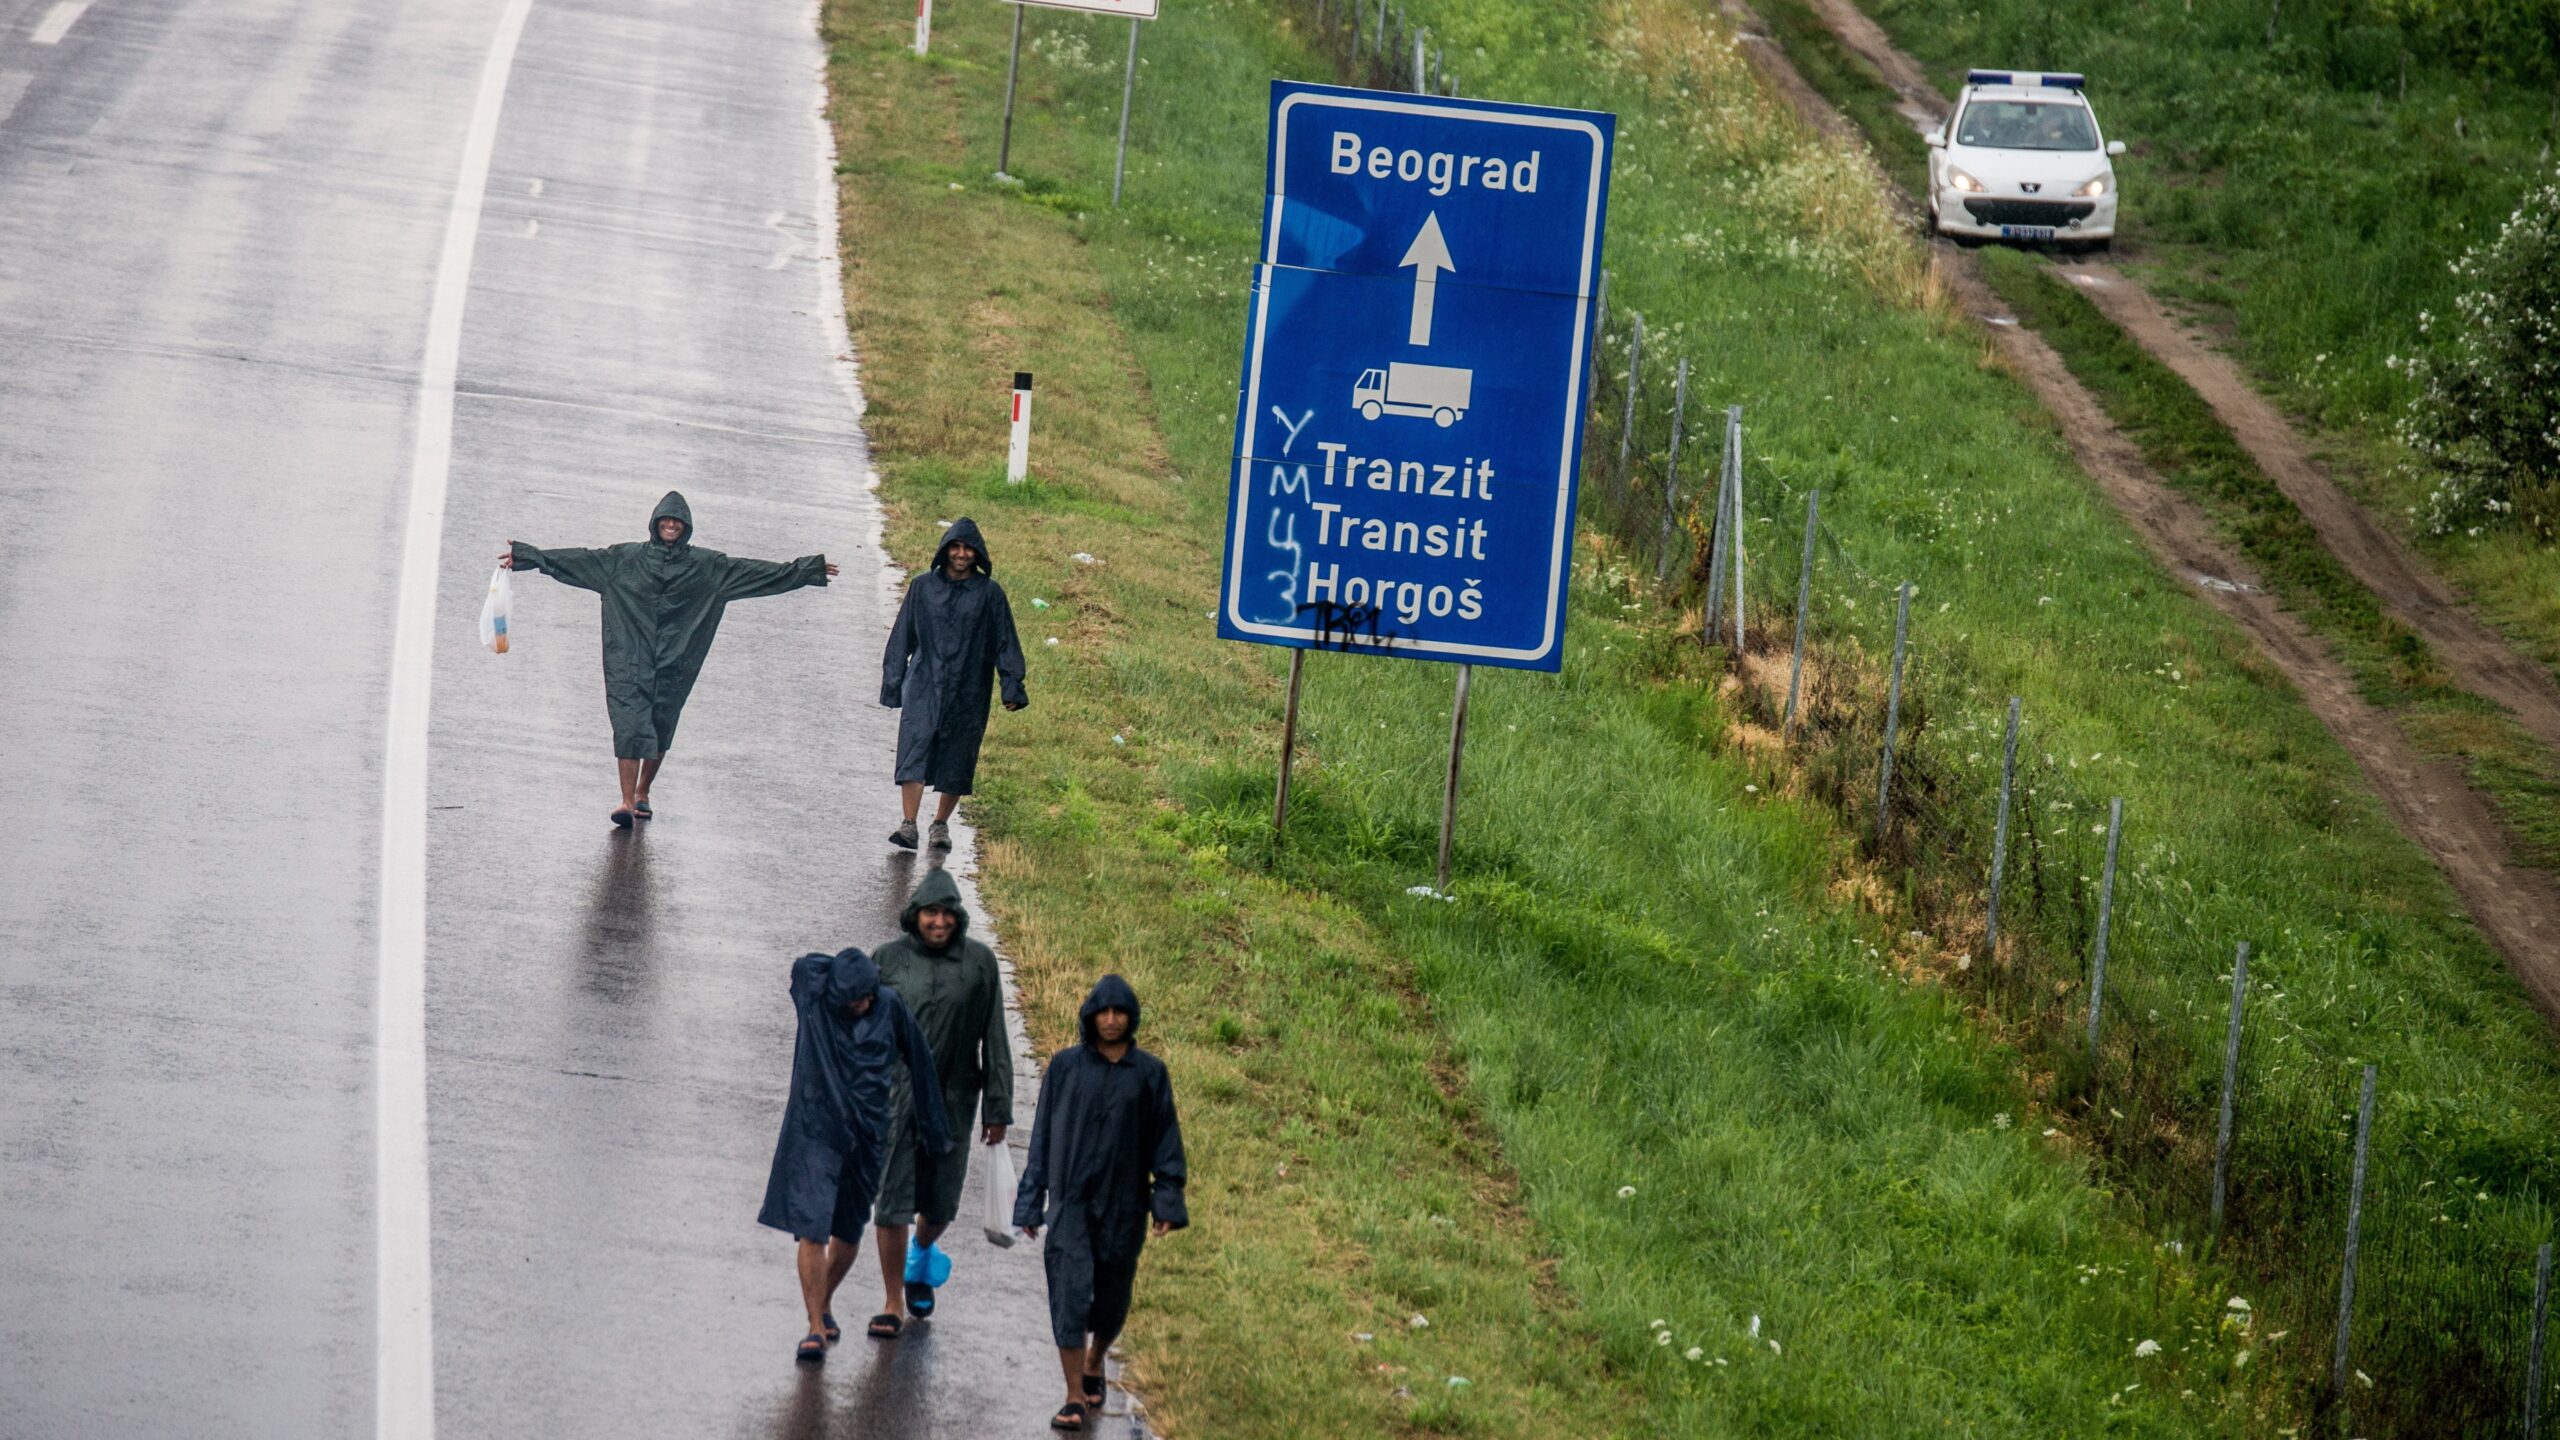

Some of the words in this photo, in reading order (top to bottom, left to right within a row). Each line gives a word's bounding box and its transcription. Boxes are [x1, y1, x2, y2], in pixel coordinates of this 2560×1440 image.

[1330, 130, 1541, 197] Beograd
[1316, 440, 1495, 501] Tranzit
[1311, 501, 1488, 561] Transit
[1306, 561, 1484, 625] Horgoš
